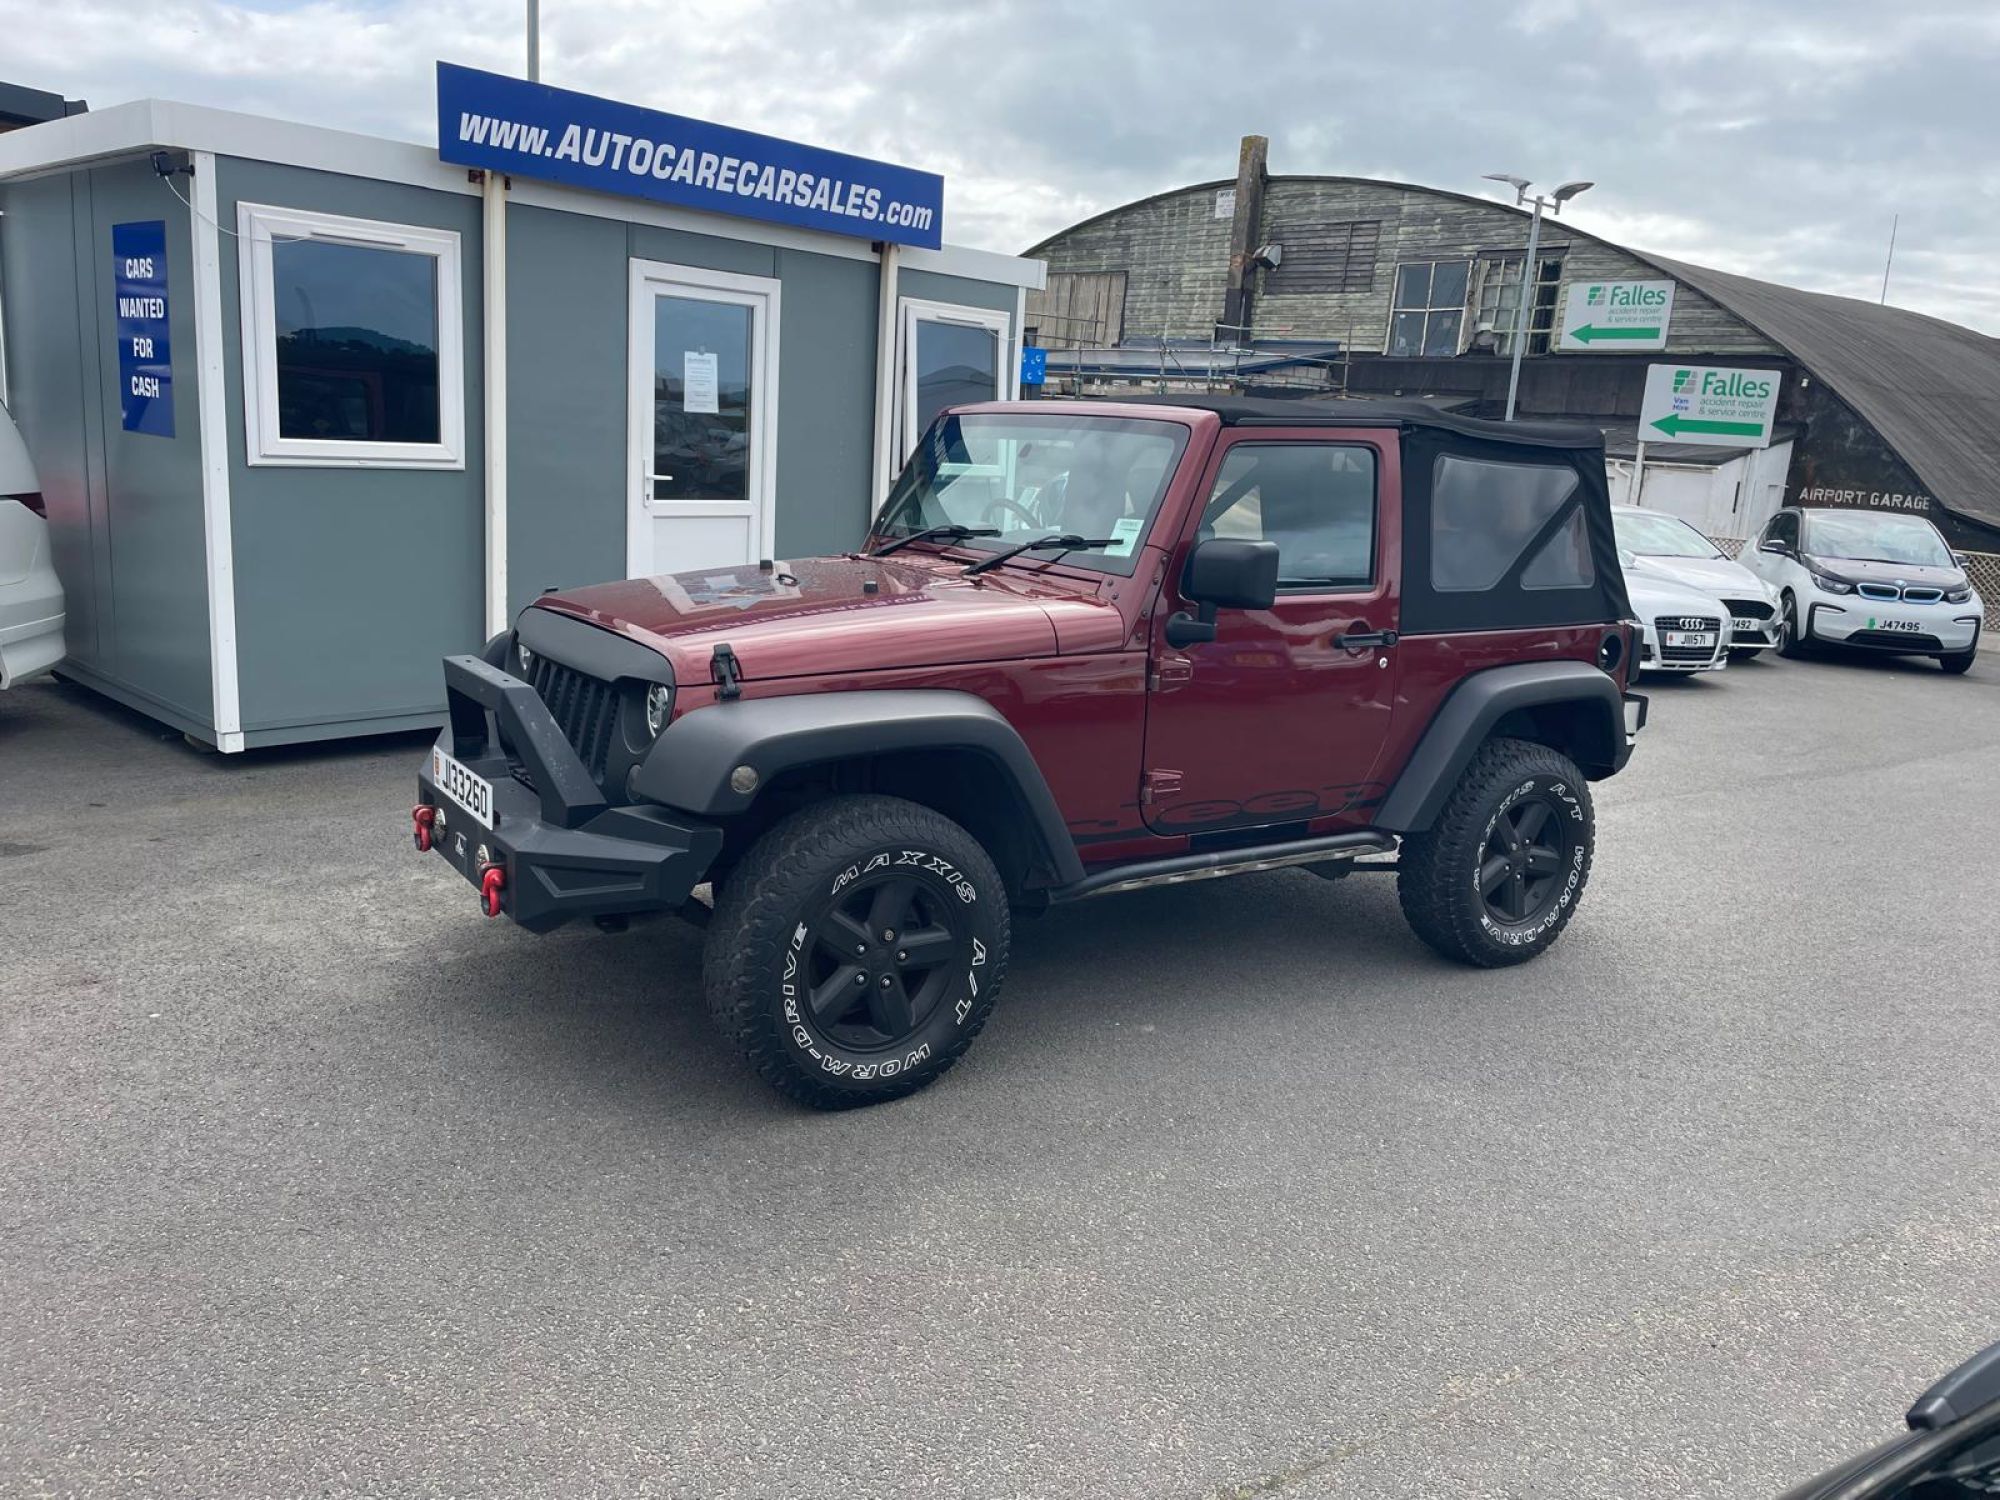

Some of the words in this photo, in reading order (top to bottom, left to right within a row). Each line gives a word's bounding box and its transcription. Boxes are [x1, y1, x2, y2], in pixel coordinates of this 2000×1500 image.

[459, 111, 934, 231] www.AUTOCARECARSALES.com
[125, 258, 153, 279] CARS
[1610, 285, 1667, 306] Falles
[119, 298, 164, 319] WANTED
[1608, 307, 1637, 315] accident
[1640, 307, 1661, 316] repair
[133, 337, 153, 359] FOR
[131, 375, 160, 399] CASH
[1701, 371, 1771, 398] Falles
[1698, 407, 1705, 415] &
[1707, 408, 1737, 416] service
[1739, 409, 1767, 419] centre
[1699, 397, 1736, 407] accident
[1739, 399, 1765, 410] repair
[1799, 487, 1866, 505] AIRPORT
[1869, 492, 1931, 511] GARAGE
[1879, 620, 1921, 632] J47495
[442, 758, 488, 820] J133260
[1549, 782, 1583, 821] A/T
[831, 850, 976, 904] MAXXIS
[954, 936, 987, 1026] A/T
